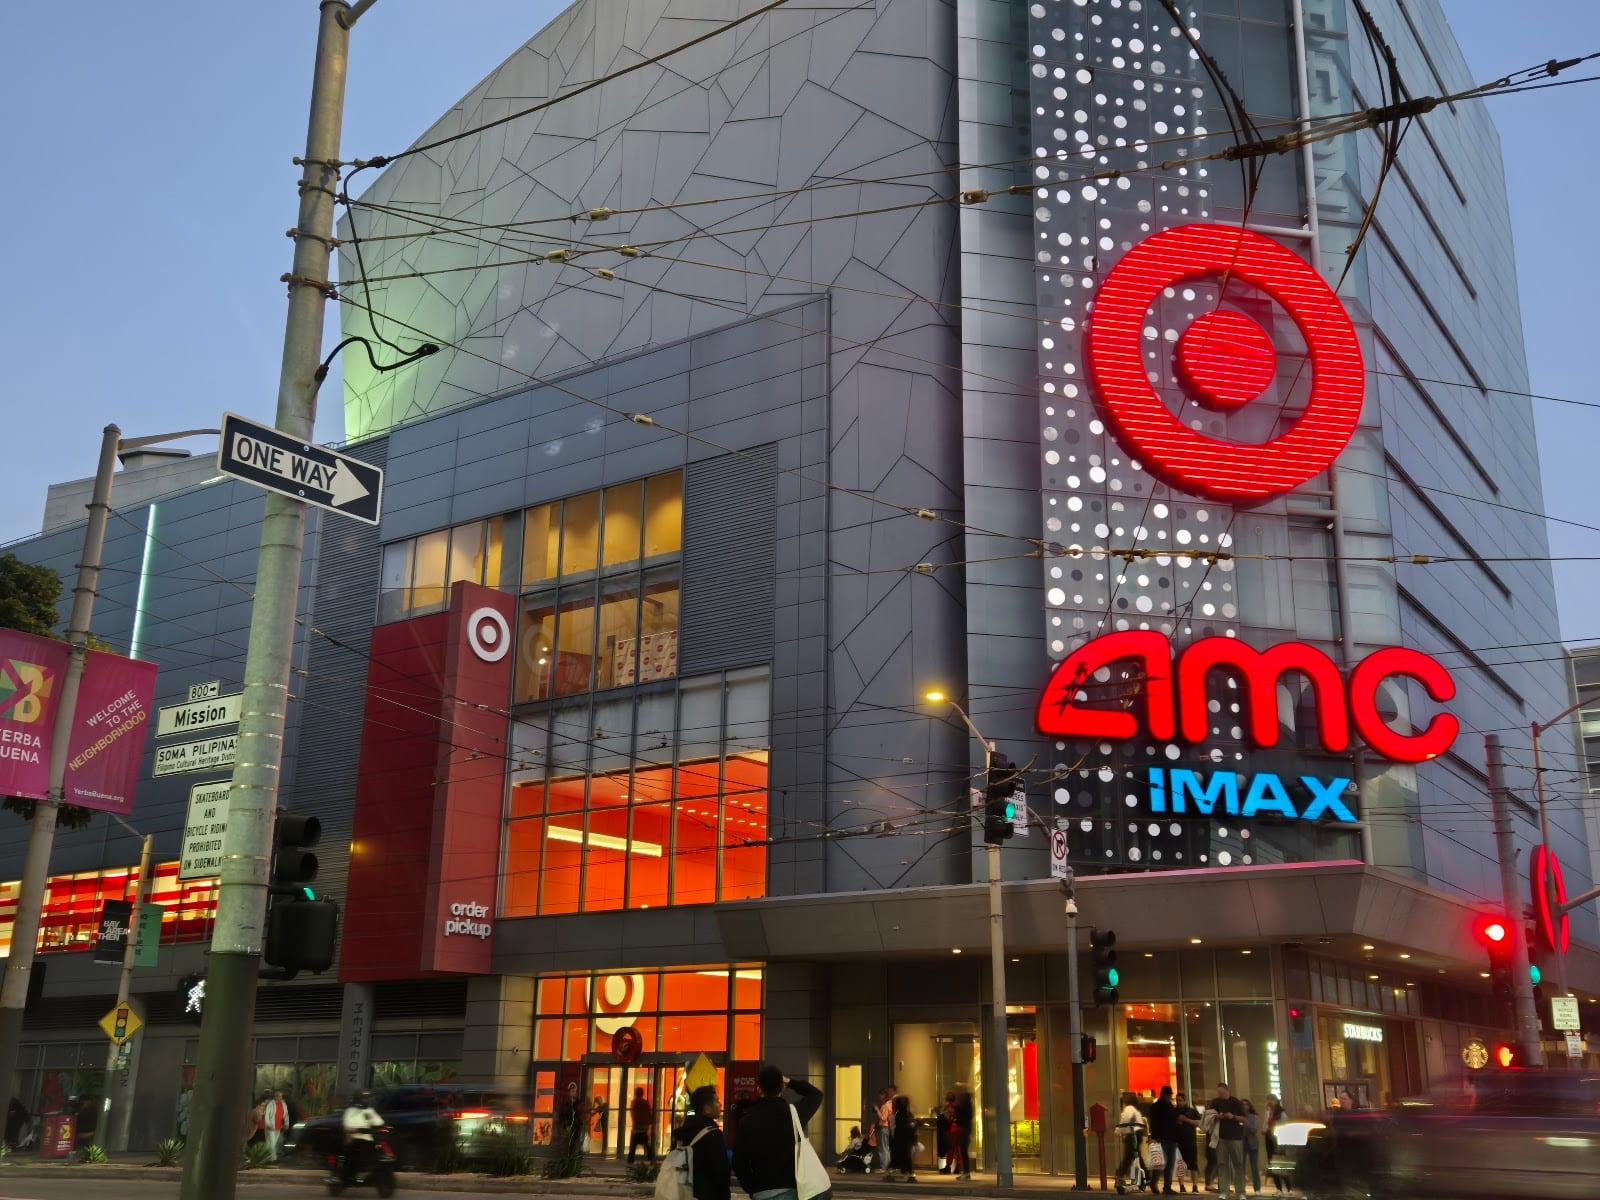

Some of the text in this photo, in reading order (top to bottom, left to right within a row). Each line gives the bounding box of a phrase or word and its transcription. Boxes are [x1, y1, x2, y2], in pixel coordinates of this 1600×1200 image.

[237, 437, 338, 491] ONE WAY
[191, 684, 209, 699] 800
[86, 689, 137, 727] WELCOME
[105, 699, 143, 728] TO THE
[174, 705, 226, 728] Mission
[0, 728, 41, 749] ERBA
[68, 710, 147, 772] NEIGHBORHOOD
[158, 747, 186, 762] SOMA
[176, 758, 197, 769] Cultural
[198, 754, 220, 765] Heritage
[1148, 767, 1358, 823] IMAX
[203, 807, 216, 819] AND
[186, 824, 209, 838] BICYCLE
[189, 839, 222, 853] PROHIBITED
[183, 859, 192, 870] ON
[450, 901, 489, 918] order
[103, 920, 120, 928] BAY
[105, 926, 129, 936] AREA
[443, 917, 492, 940] pickup
[98, 932, 120, 941] THEN
[1343, 1023, 1384, 1042] STARBUCKS
[347, 1002, 364, 1083] METREON
